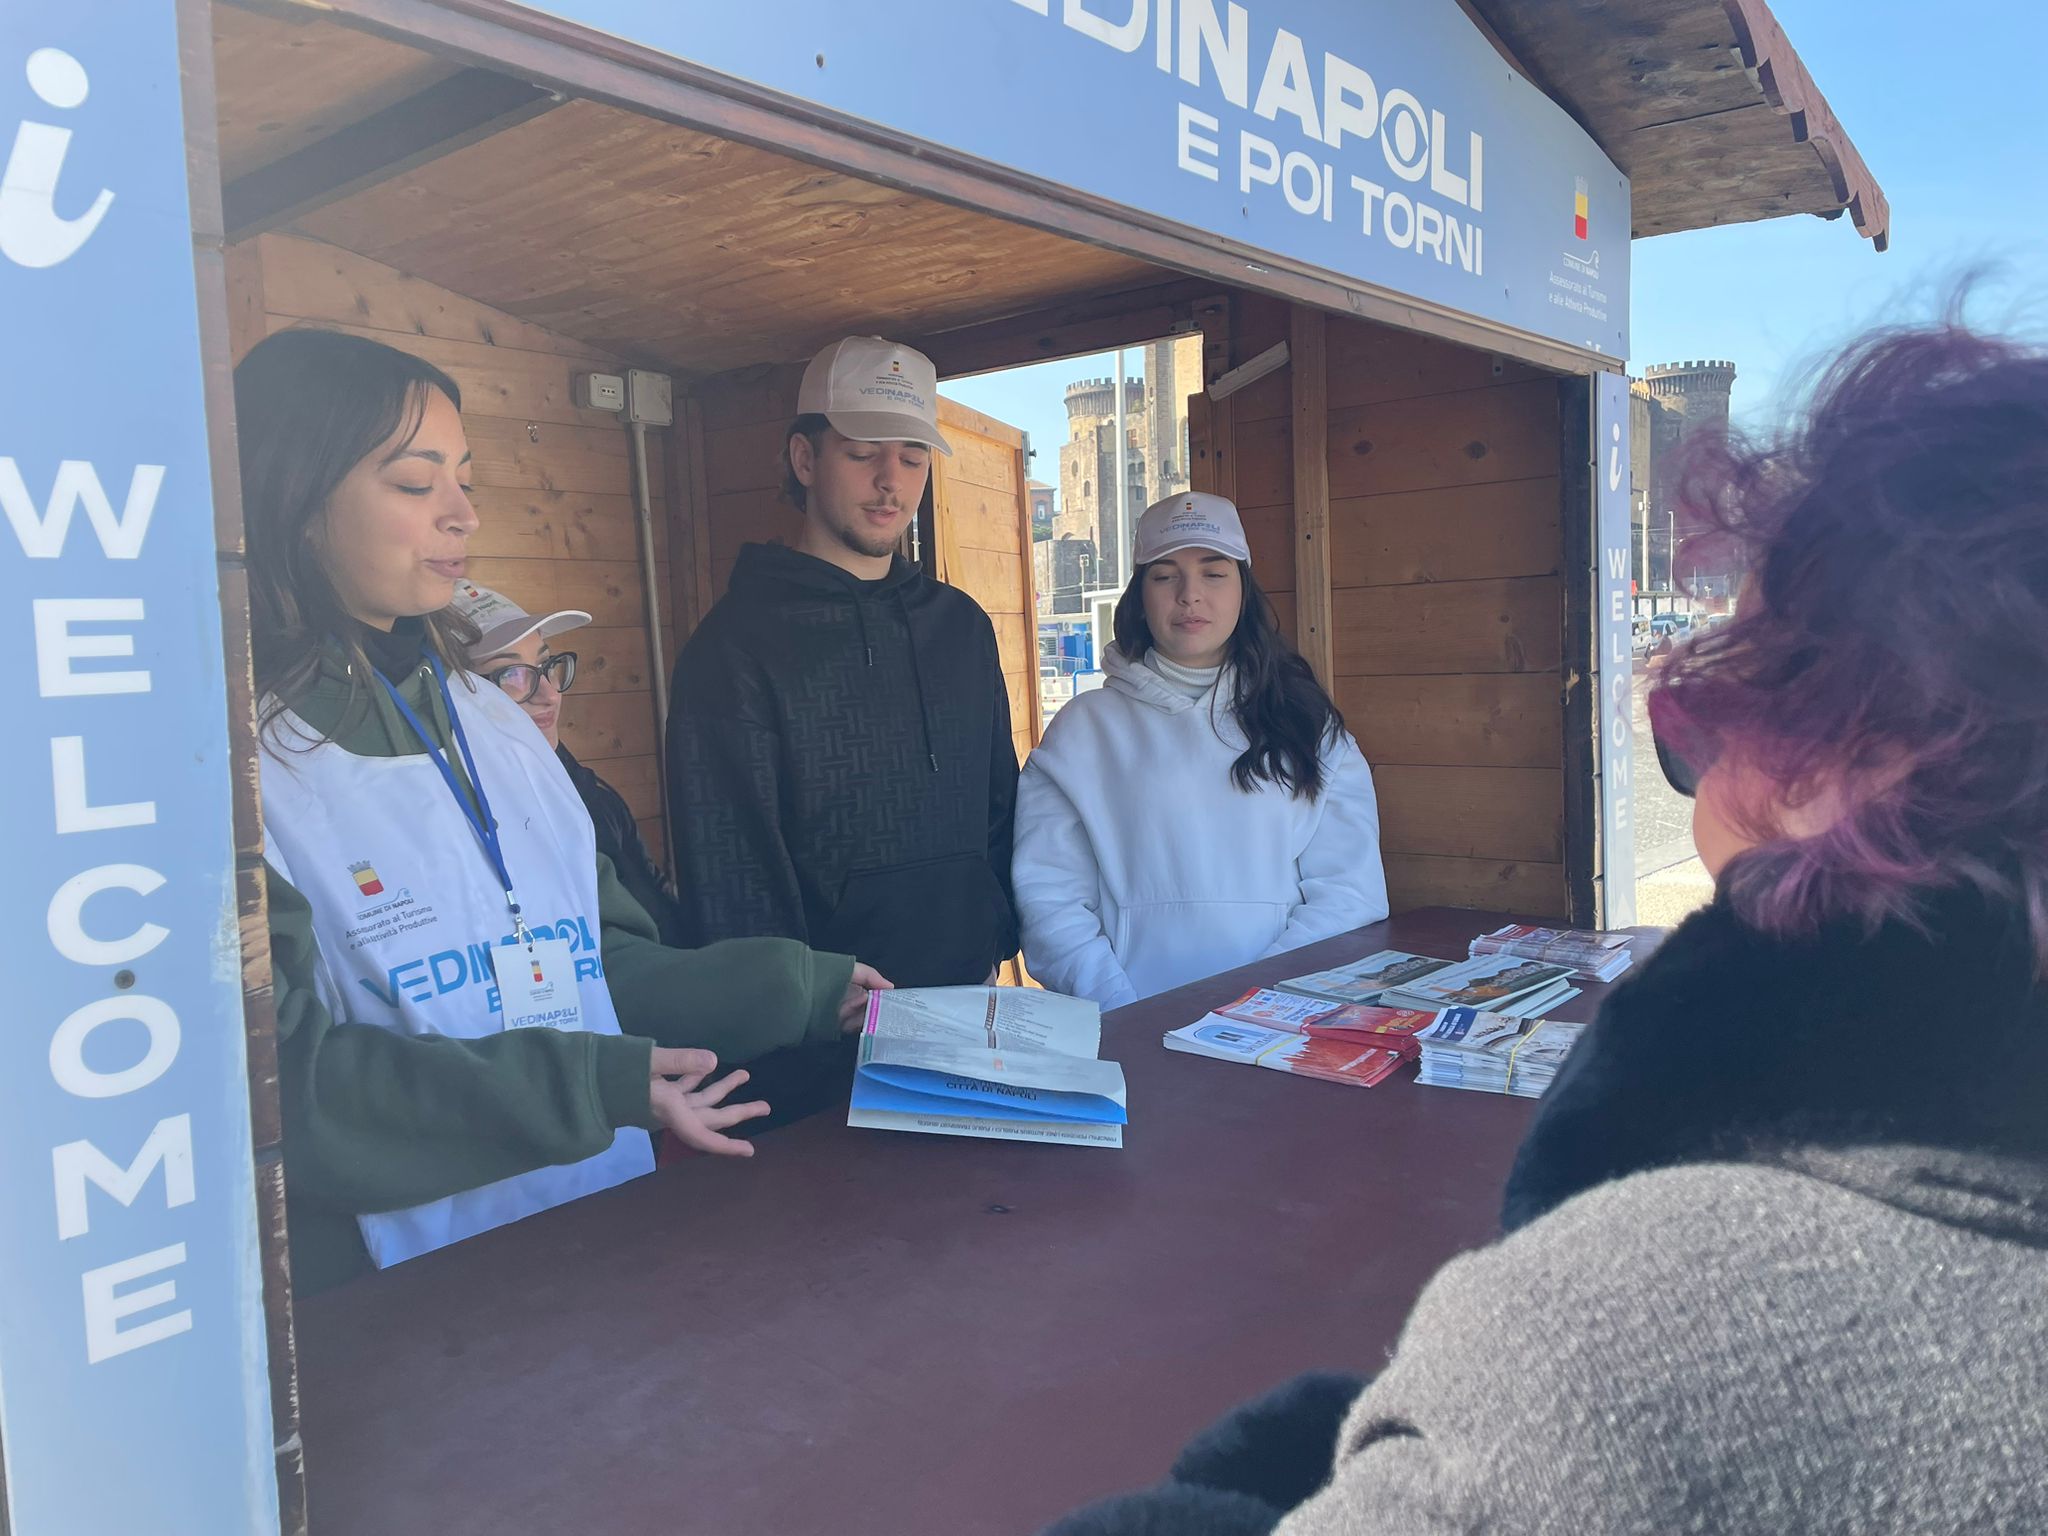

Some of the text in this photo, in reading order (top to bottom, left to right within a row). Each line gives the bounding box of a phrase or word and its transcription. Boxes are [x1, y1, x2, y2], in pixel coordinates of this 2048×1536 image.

[1010, 0, 1483, 213] INAPOLI
[1177, 102, 1483, 277] E POI TORNI
[1608, 548, 1629, 830] WELCOME
[0, 456, 196, 1364] WELCOME
[346, 906, 433, 938] Assorato al Turismo
[398, 916, 438, 933] Produttive
[511, 1006, 578, 1027] VEDINAPOLI
[982, 1085, 994, 1094] DI
